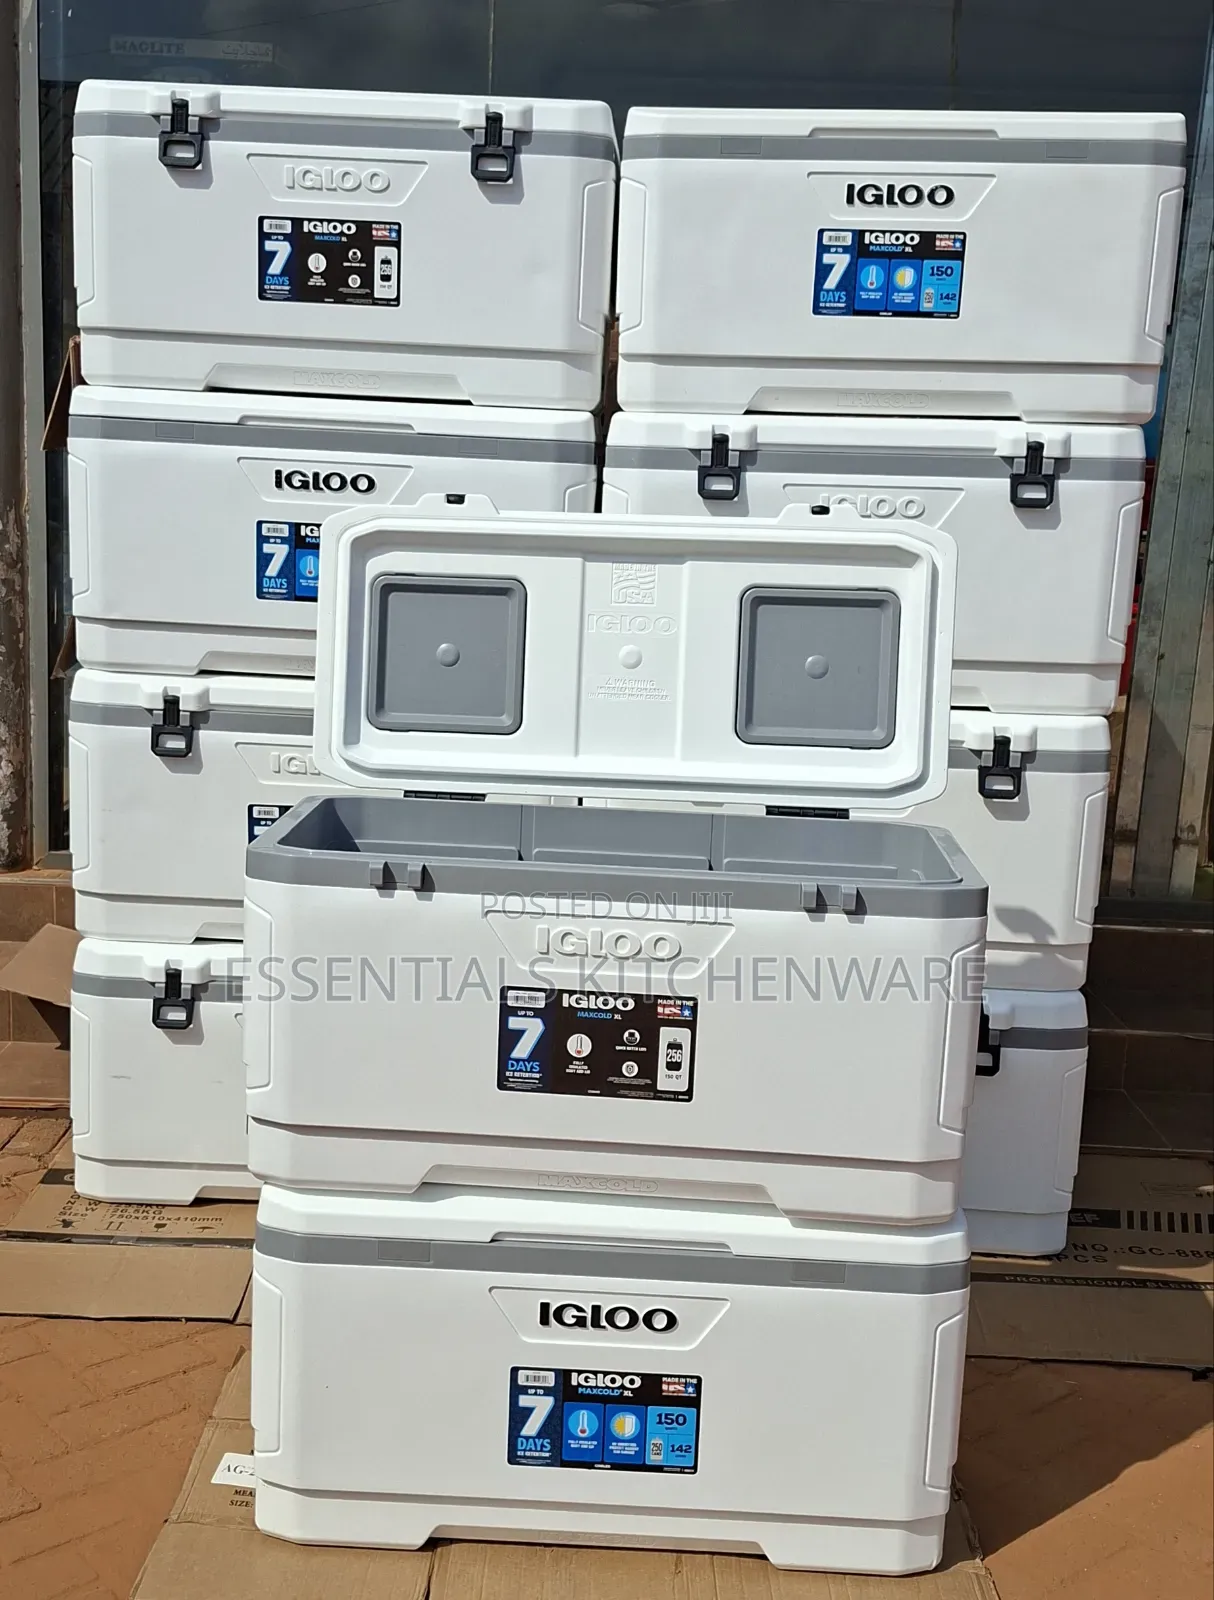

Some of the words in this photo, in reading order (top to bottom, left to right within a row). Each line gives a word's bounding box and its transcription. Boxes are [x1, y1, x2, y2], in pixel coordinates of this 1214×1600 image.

[114, 40, 185, 54] MAGLITE
[283, 164, 391, 194] IGLOO
[846, 183, 955, 208] IGLOO
[303, 220, 357, 235] IGLOO
[864, 231, 920, 245] IGLOO
[264, 240, 292, 275] 7
[380, 264, 392, 275] 256
[822, 253, 850, 290] 7
[929, 266, 954, 277] 150
[265, 276, 290, 285] DAYS
[820, 291, 846, 302] DAYS
[940, 293, 957, 301] 142
[274, 468, 377, 494] IGLOO
[263, 543, 289, 577] 7
[263, 578, 287, 588] DAYS
[613, 588, 655, 605] USA
[587, 613, 677, 636] IGLOO
[536, 925, 681, 962] IGLOO
[562, 993, 635, 1010] IGLOO
[577, 1011, 613, 1020] MAXCOLD
[508, 1016, 545, 1059] 7
[666, 1048, 682, 1062] 256
[508, 1060, 540, 1072] DAYS
[537, 1174, 659, 1193] MAXCOLD
[1005, 1276, 1144, 1288] PROFESSIONAL
[539, 1301, 678, 1333] IGLOO
[571, 1372, 641, 1388] IGLOO
[578, 1387, 621, 1396] MAXCOLD
[518, 1394, 555, 1436] 7
[656, 1412, 687, 1426] 150
[517, 1438, 551, 1451] DAYS
[651, 1443, 662, 1452] 250
[670, 1444, 692, 1453] 142
[229, 1499, 254, 1509] SIZE:
